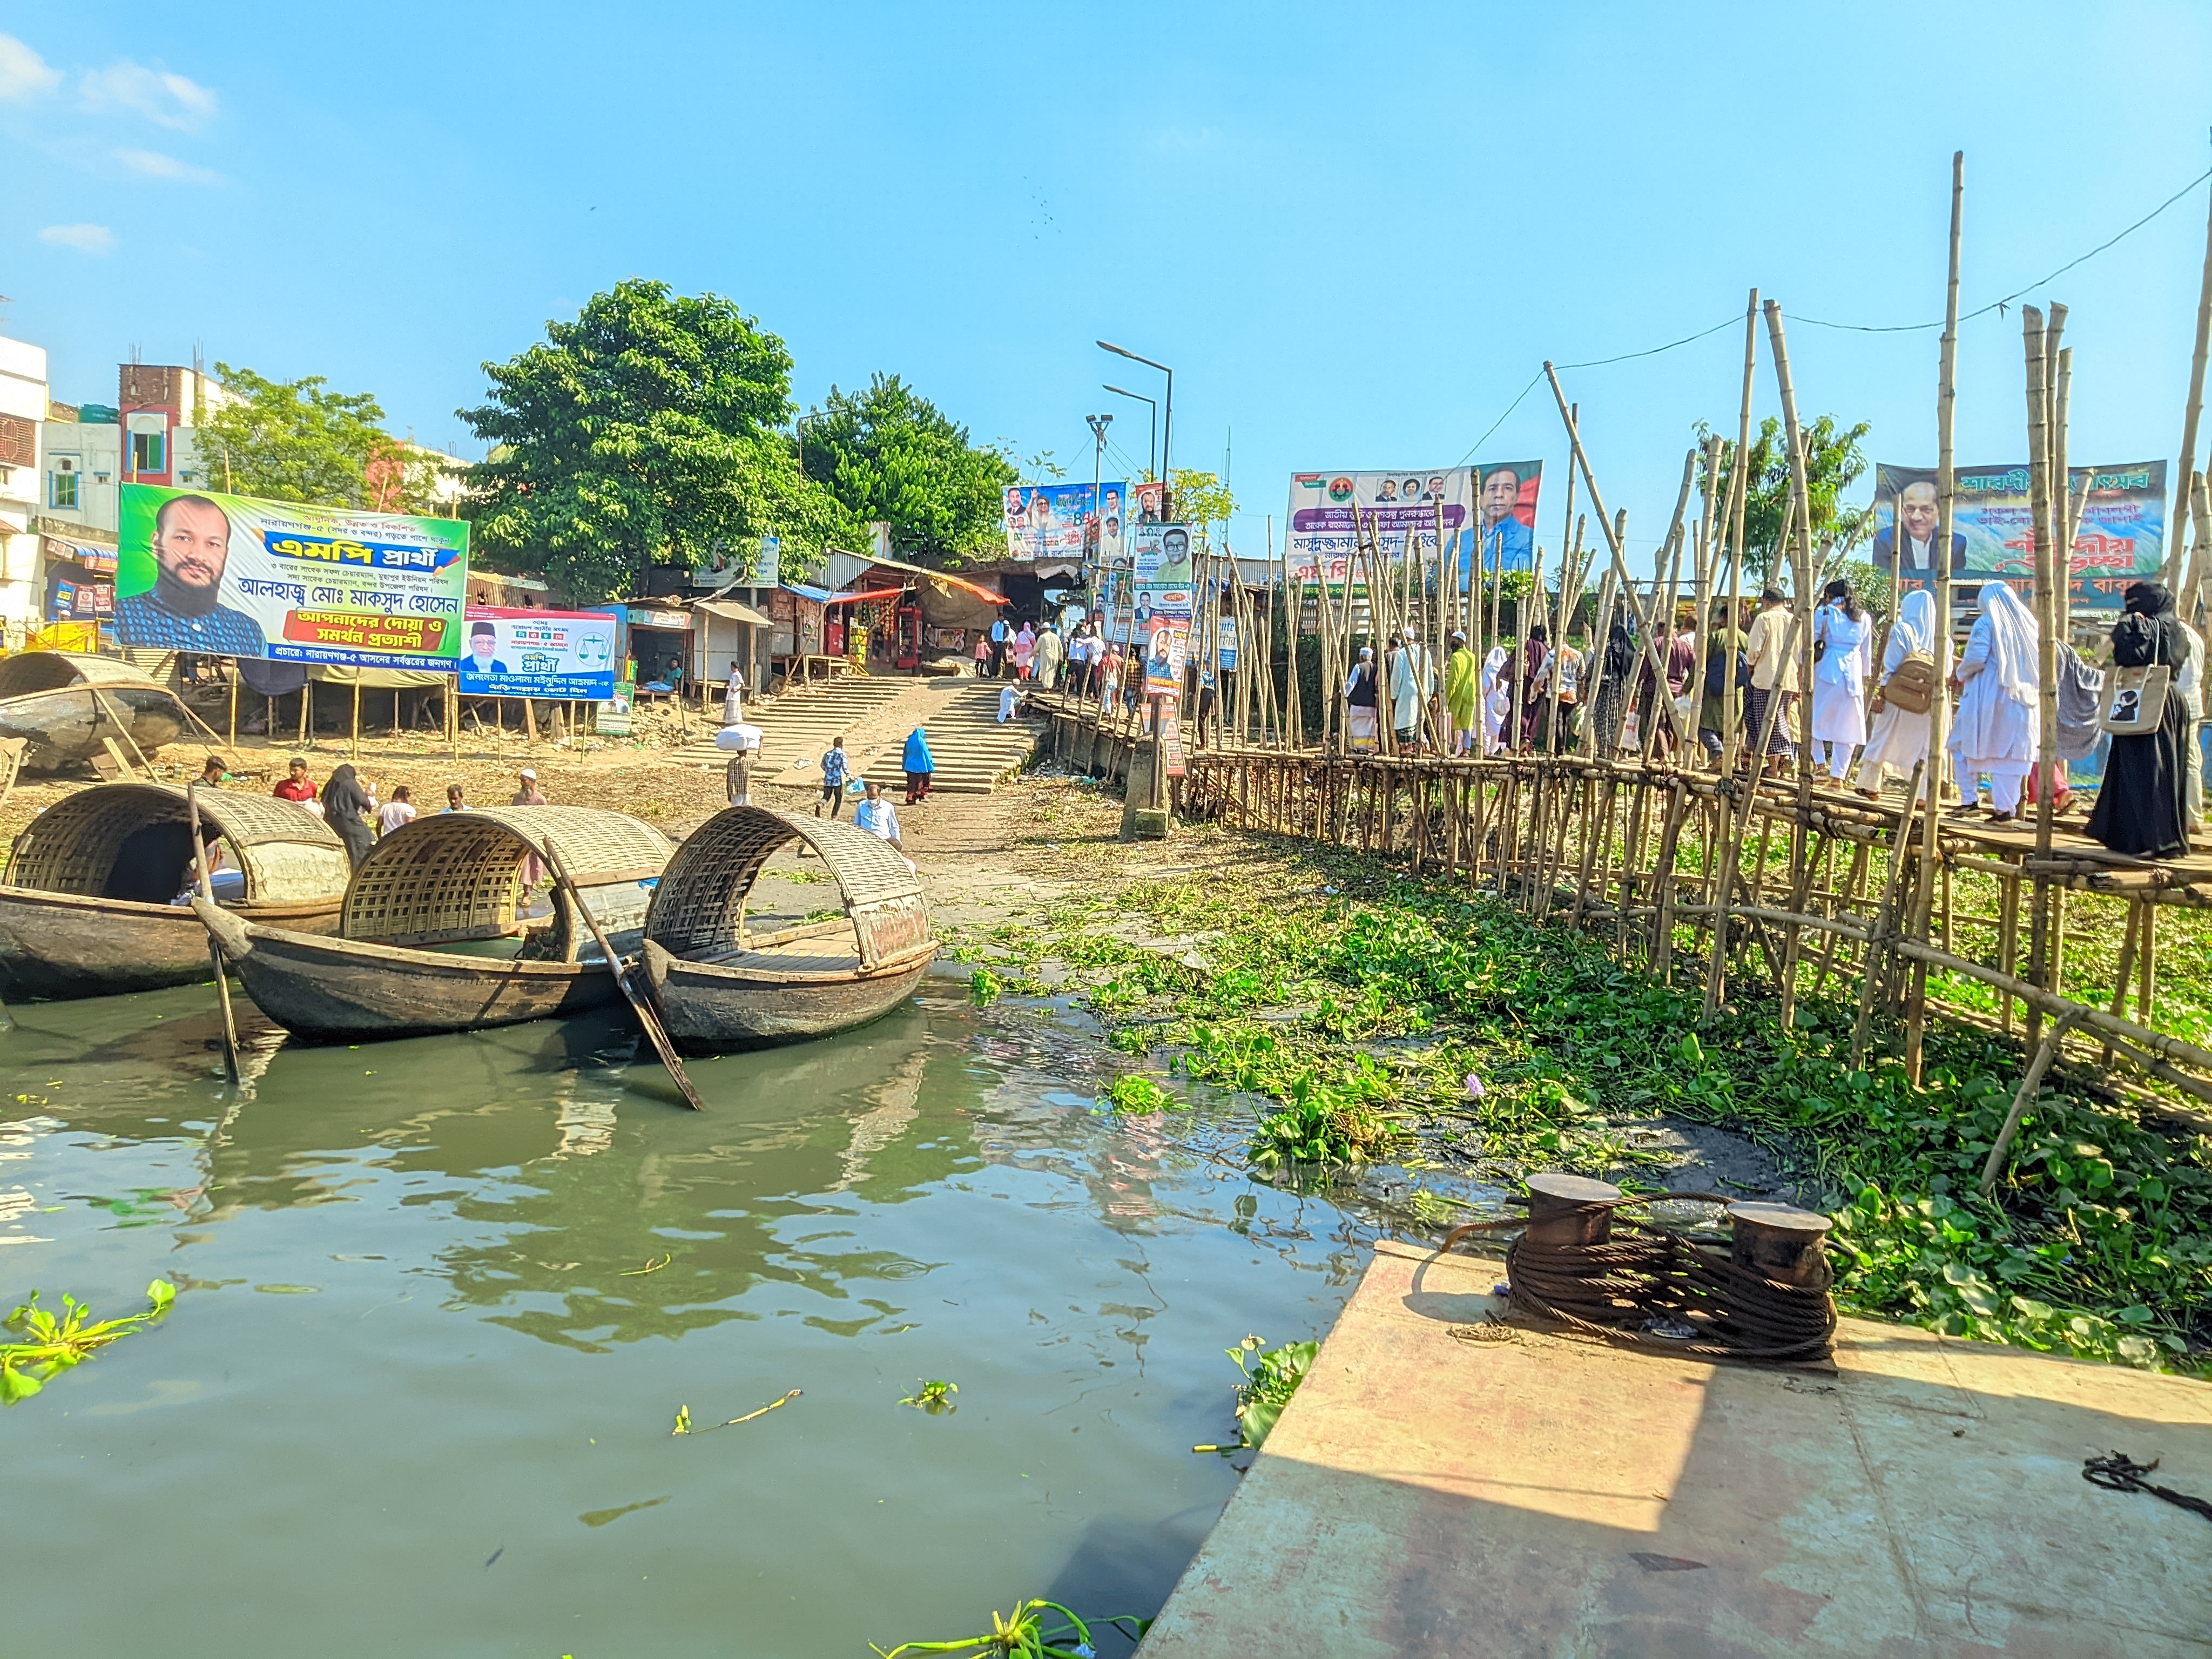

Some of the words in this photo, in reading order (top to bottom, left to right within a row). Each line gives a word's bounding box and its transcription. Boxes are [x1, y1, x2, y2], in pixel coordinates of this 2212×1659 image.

[1961, 468, 2032, 491] শারদী
[1325, 509, 1348, 518] জাতীয়
[1376, 510, 1398, 520] ণতন্ত্র
[2099, 514, 2144, 524] জানাই
[261, 518, 324, 532] নারায়ণগঞ্জ-৫
[328, 525, 348, 534] (সদর
[360, 530, 382, 539] বন্দর)
[386, 531, 407, 541] গড়তে
[410, 534, 428, 542] পাশে
[430, 536, 450, 545] থাকুন
[303, 515, 341, 526] আধুনিক,
[345, 518, 367, 528] উন্নত
[382, 522, 416, 532] বিকশিত
[1305, 522, 1326, 530] তারেক
[272, 539, 374, 564] এমপি
[382, 548, 439, 567] প্রার্থী
[302, 575, 323, 583] সাবেক
[380, 581, 406, 591] উপজেলা
[401, 573, 427, 583] ইউনিয়ন
[429, 576, 449, 585] পরিষদ
[238, 577, 307, 606] আলহাজ্ব
[312, 585, 343, 604] মোঃ
[349, 589, 405, 615] মাকসুদ
[409, 594, 459, 614] হোসেন
[298, 611, 380, 629] আপনাদের
[384, 617, 424, 632] দোয়া
[428, 621, 443, 632] ও
[316, 627, 365, 644] সমর্থন
[368, 632, 422, 648] প্রত্যাশী
[306, 649, 357, 662] নারায়ণগঞ্জ-৫
[359, 653, 391, 664] আসনের
[393, 654, 426, 666] সর্বস্তরের
[522, 658, 559, 672] প্রার্থী
[466, 673, 498, 681] জননেতা
[500, 675, 532, 683] মাওলানা
[534, 675, 567, 687] মইনুদ্দিন
[568, 678, 597, 686] আহমাদ
